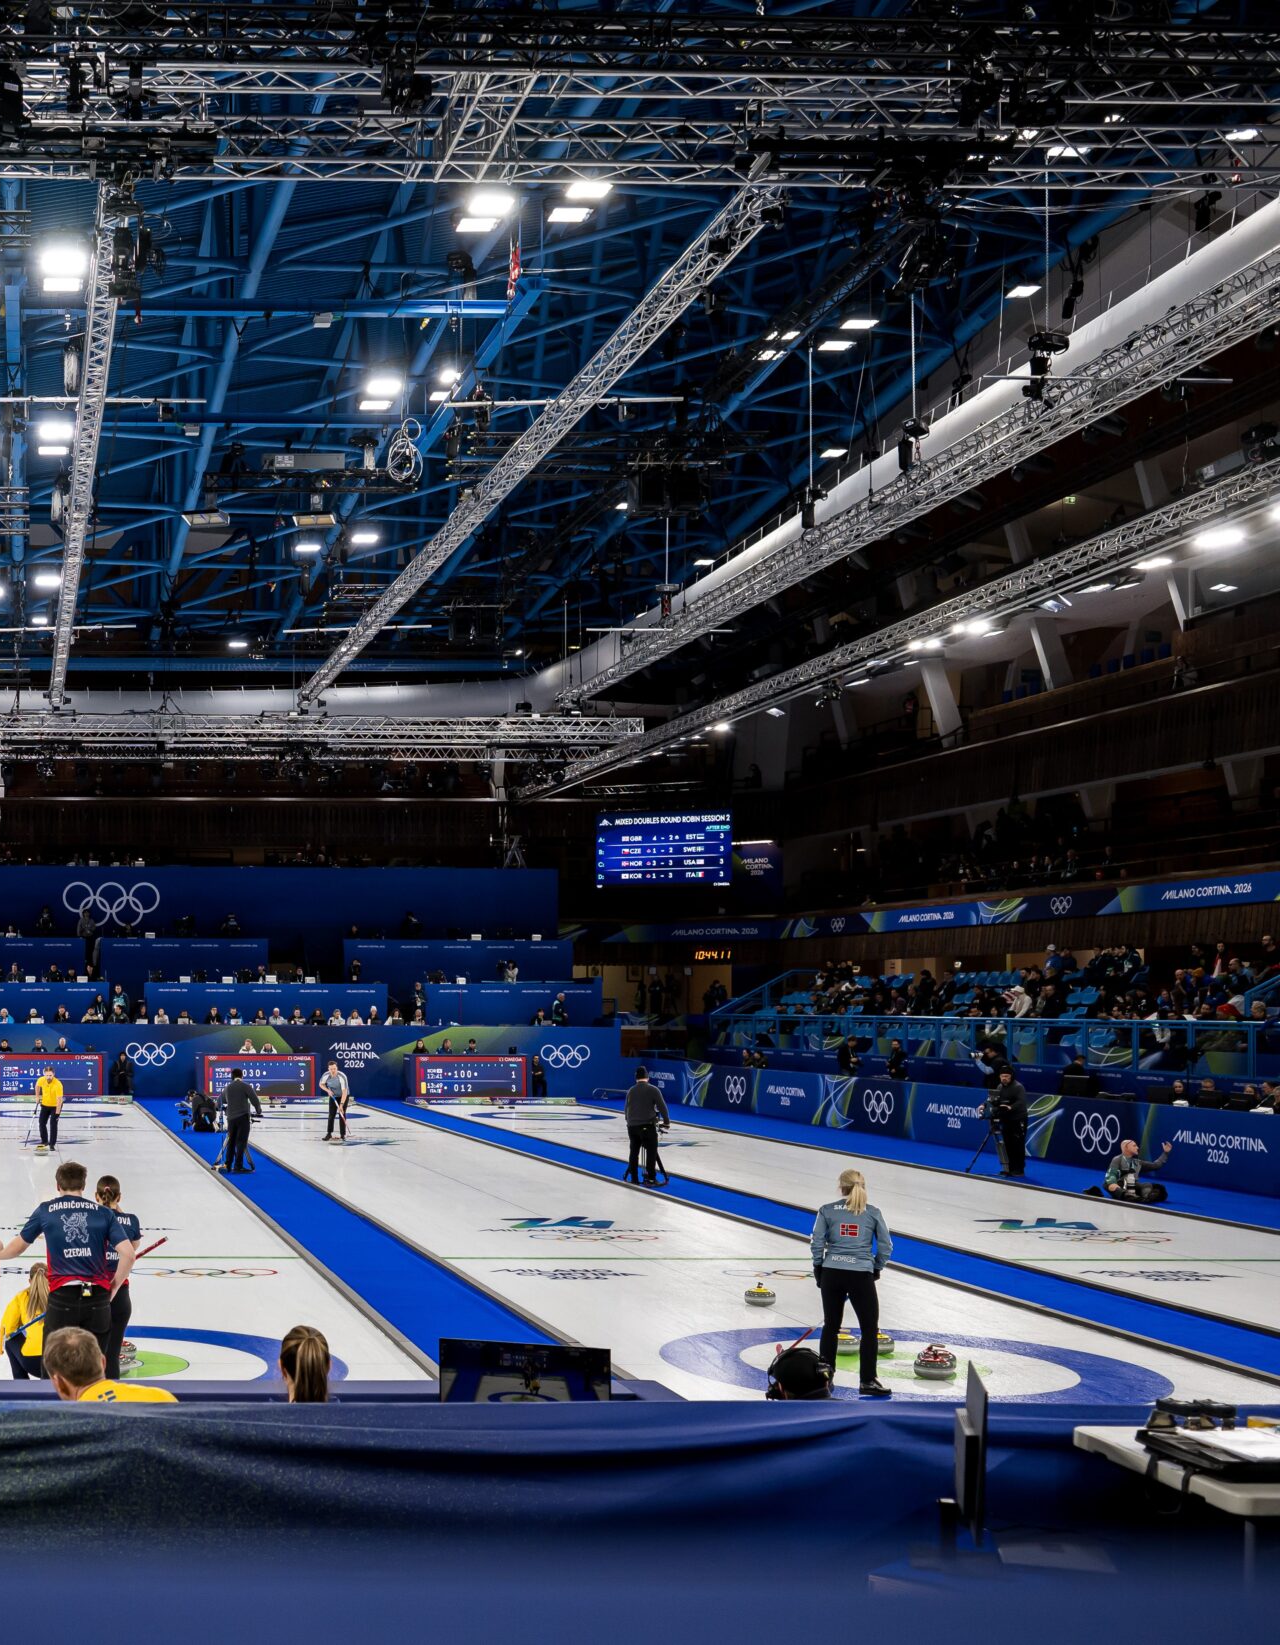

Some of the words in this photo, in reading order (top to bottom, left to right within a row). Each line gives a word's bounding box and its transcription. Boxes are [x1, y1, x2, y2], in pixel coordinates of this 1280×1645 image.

[614, 818, 633, 826] MIXED
[633, 817, 660, 825] DOUBLES
[660, 816, 681, 824] ROUND
[681, 815, 701, 823] ROBIN
[701, 814, 726, 822] SESSION
[726, 814, 731, 822] 2
[741, 857, 769, 865] MILANO
[1161, 888, 1195, 901] MILANO
[1196, 884, 1232, 898] CORTINA
[1234, 883, 1252, 894] 2026
[898, 914, 920, 923] MILANO
[920, 913, 942, 922] CORTINA
[943, 911, 954, 920] 2026
[671, 928, 704, 936] MILANO
[741, 927, 758, 935] 2026
[328, 1042, 372, 1050] MILANO
[336, 1051, 381, 1060] CORTINA
[344, 1060, 365, 1068] 2026
[29, 1068, 34, 1076] 0
[36, 1068, 41, 1076] 1
[242, 1069, 247, 1077] 0
[249, 1069, 254, 1077] 3
[255, 1069, 260, 1077] 0
[300, 1070, 305, 1078] 3
[454, 1070, 458, 1078] 1
[460, 1070, 465, 1078] 0
[466, 1070, 472, 1078] 0
[29, 1082, 34, 1090] 1
[255, 1083, 260, 1091] 2
[453, 1084, 459, 1092] 0
[460, 1084, 465, 1092] 1
[467, 1084, 472, 1092] 2
[766, 1085, 786, 1095] MILANO
[785, 1086, 806, 1098] CORTINA
[925, 1102, 954, 1116] MILANO
[953, 1105, 981, 1119] CORTIN
[947, 1117, 962, 1129] 2026
[1172, 1129, 1217, 1147] MILANO
[1218, 1134, 1268, 1153] CORTINA
[1207, 1149, 1229, 1164] 2026
[63, 1247, 92, 1258] CZECHIA
[831, 1255, 856, 1264] NORGE
